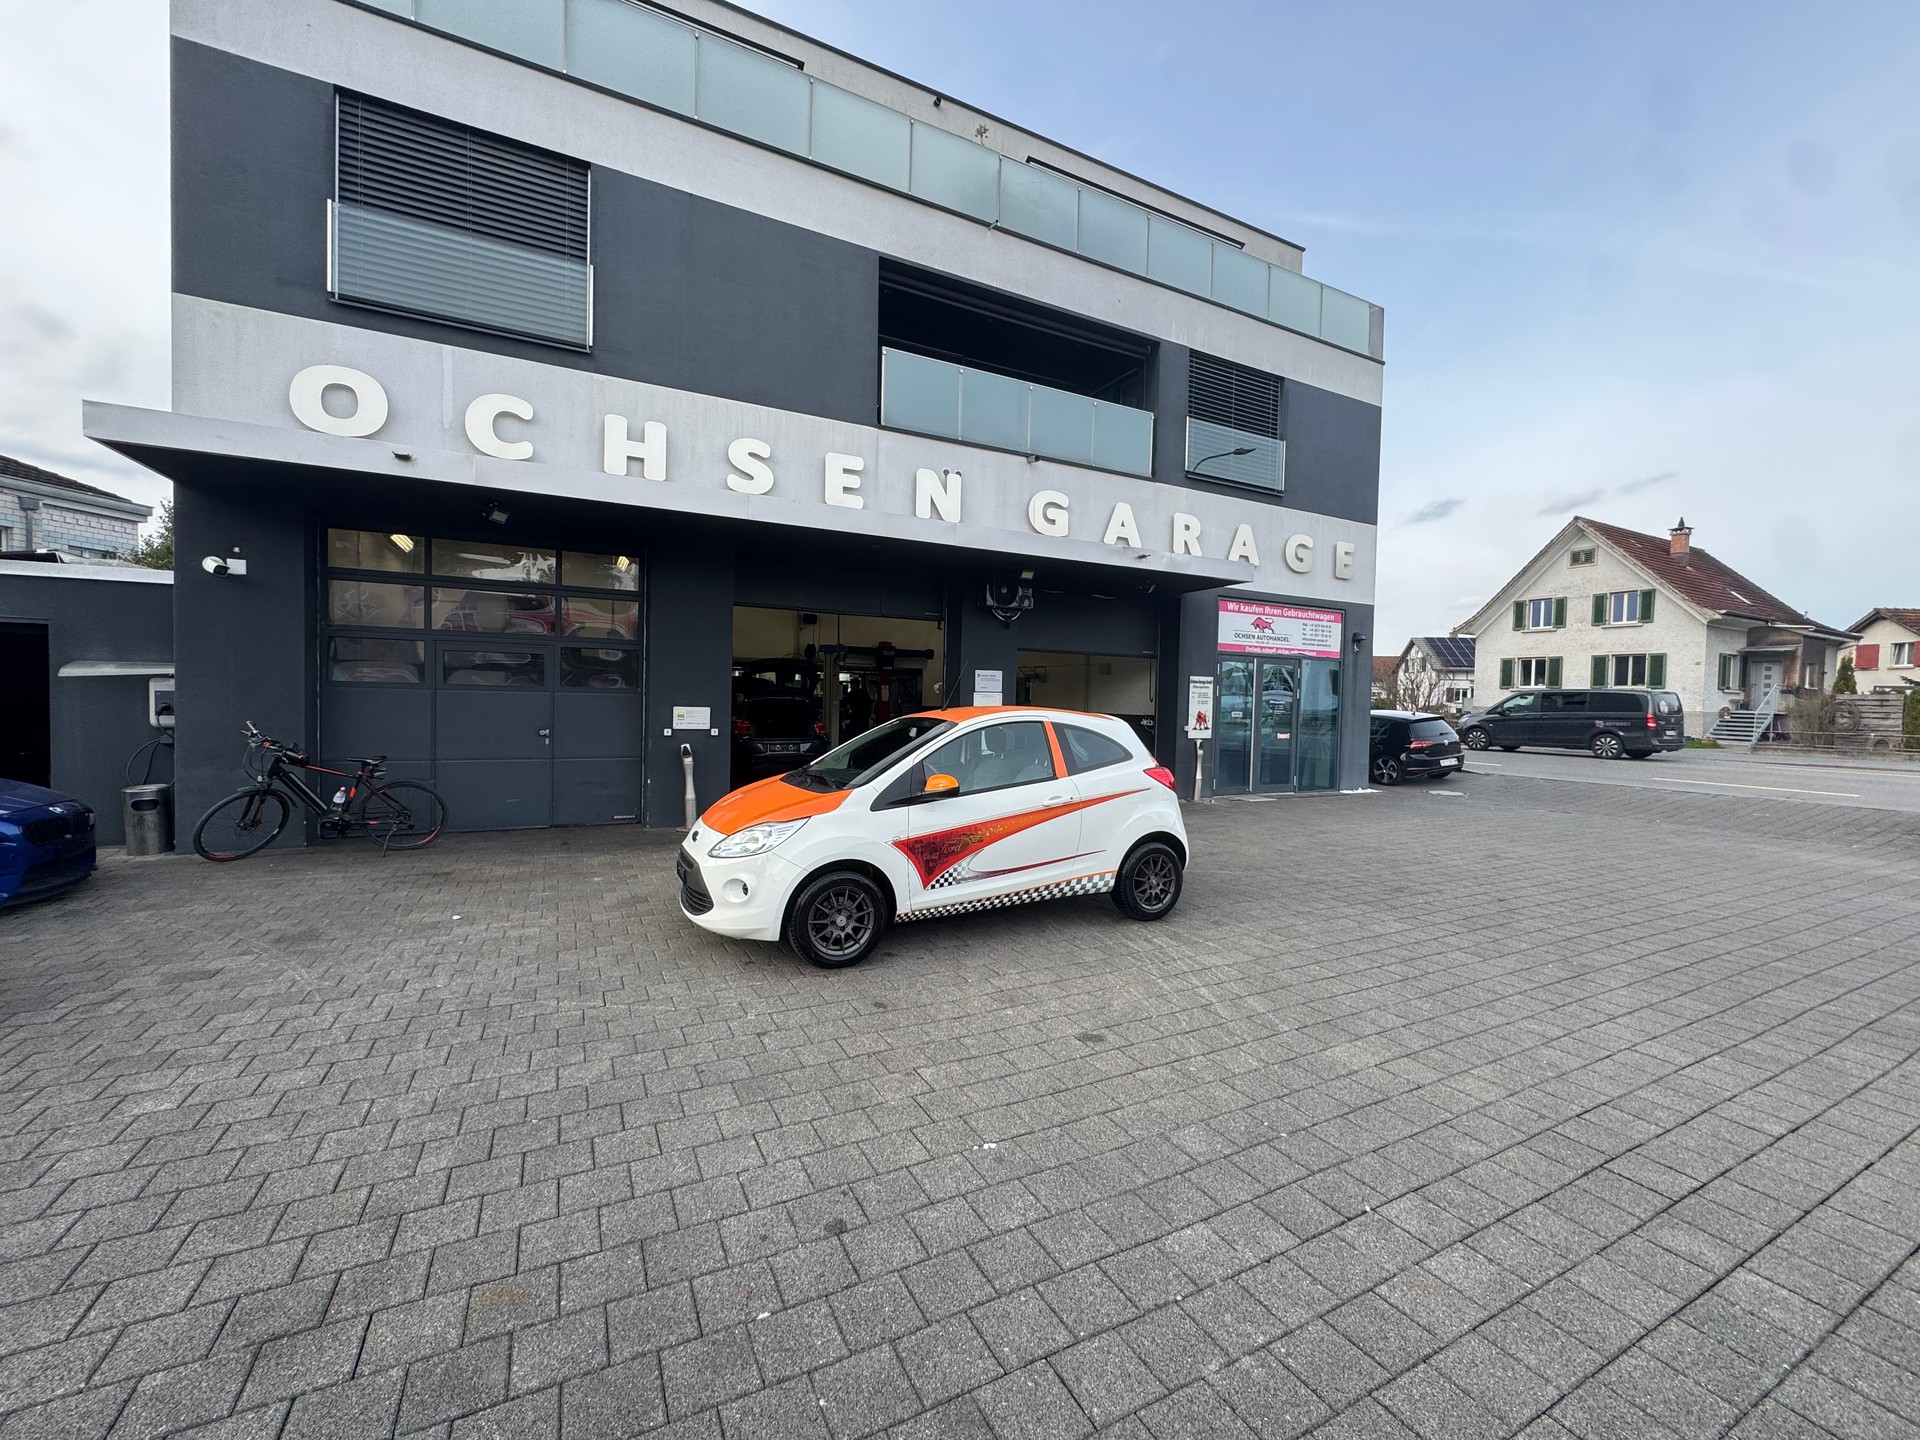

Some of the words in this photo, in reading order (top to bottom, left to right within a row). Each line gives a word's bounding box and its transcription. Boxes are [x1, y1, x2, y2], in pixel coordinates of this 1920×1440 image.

[289, 364, 961, 523] OCHSEN
[1028, 490, 1355, 579] GARAGE
[1227, 602, 1239, 611] Wir
[1240, 603, 1263, 614] kaufen
[1265, 606, 1282, 616] Ihren
[1283, 608, 1334, 621] Gebrauchtwagen
[1234, 632, 1255, 640] OCHSEN
[1256, 634, 1290, 643] AUTOHANDEL
[940, 840, 963, 853] Ford
